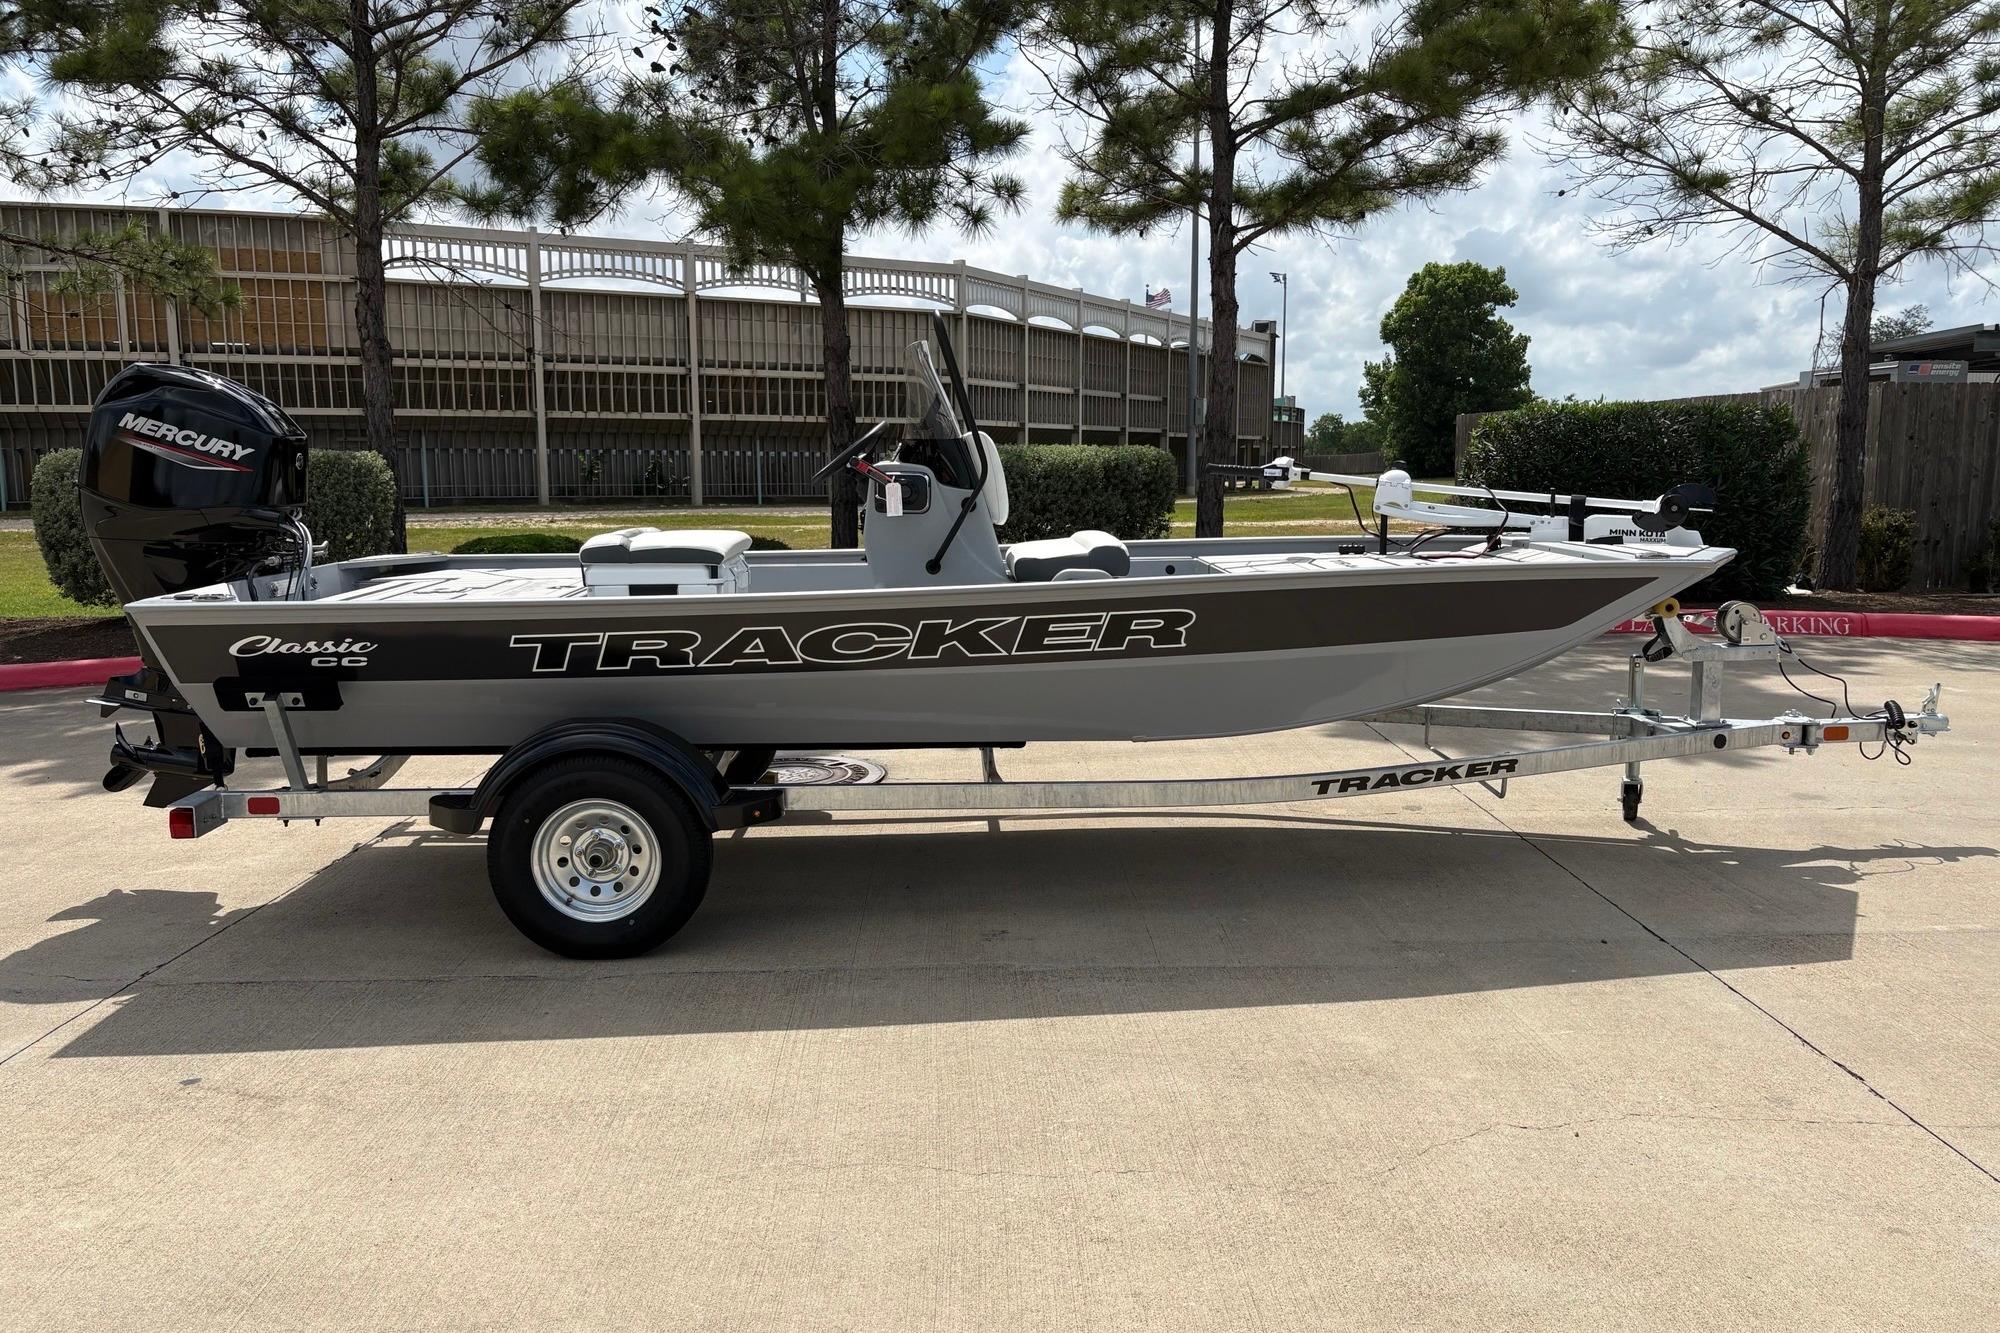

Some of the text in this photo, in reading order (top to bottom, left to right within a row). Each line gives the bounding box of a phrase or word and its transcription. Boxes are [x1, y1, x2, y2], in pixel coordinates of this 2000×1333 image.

[117, 412, 256, 461] MERCURY
[228, 635, 378, 657] Classic
[509, 608, 1196, 673] TRACKER
[311, 656, 367, 667] CC
[1311, 758, 1519, 795] TRACKER
